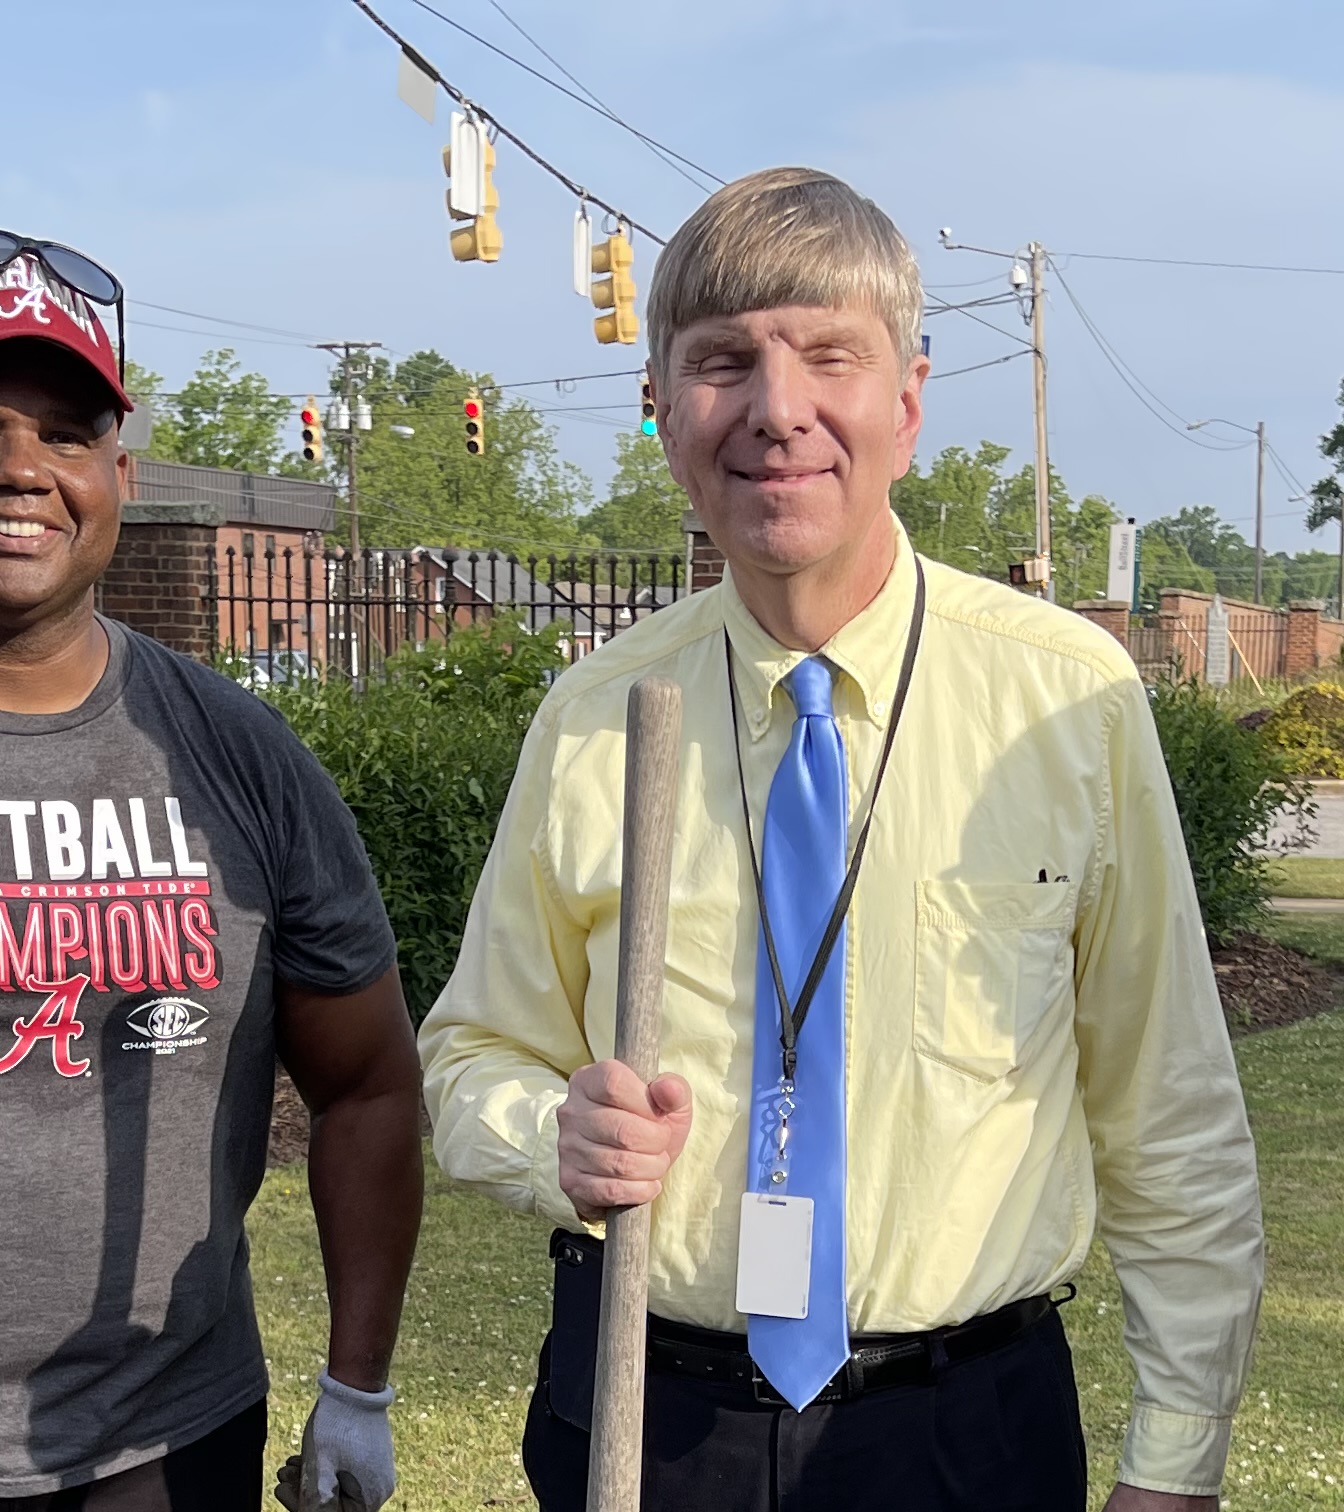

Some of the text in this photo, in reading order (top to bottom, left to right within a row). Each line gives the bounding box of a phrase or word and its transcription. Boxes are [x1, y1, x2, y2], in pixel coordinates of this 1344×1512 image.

[20, 884, 126, 898] CRIMSON
[151, 1004, 187, 1036] SEC
[121, 1036, 208, 1051] CHAMPIONSHIP
[155, 1047, 176, 1055] 2021
